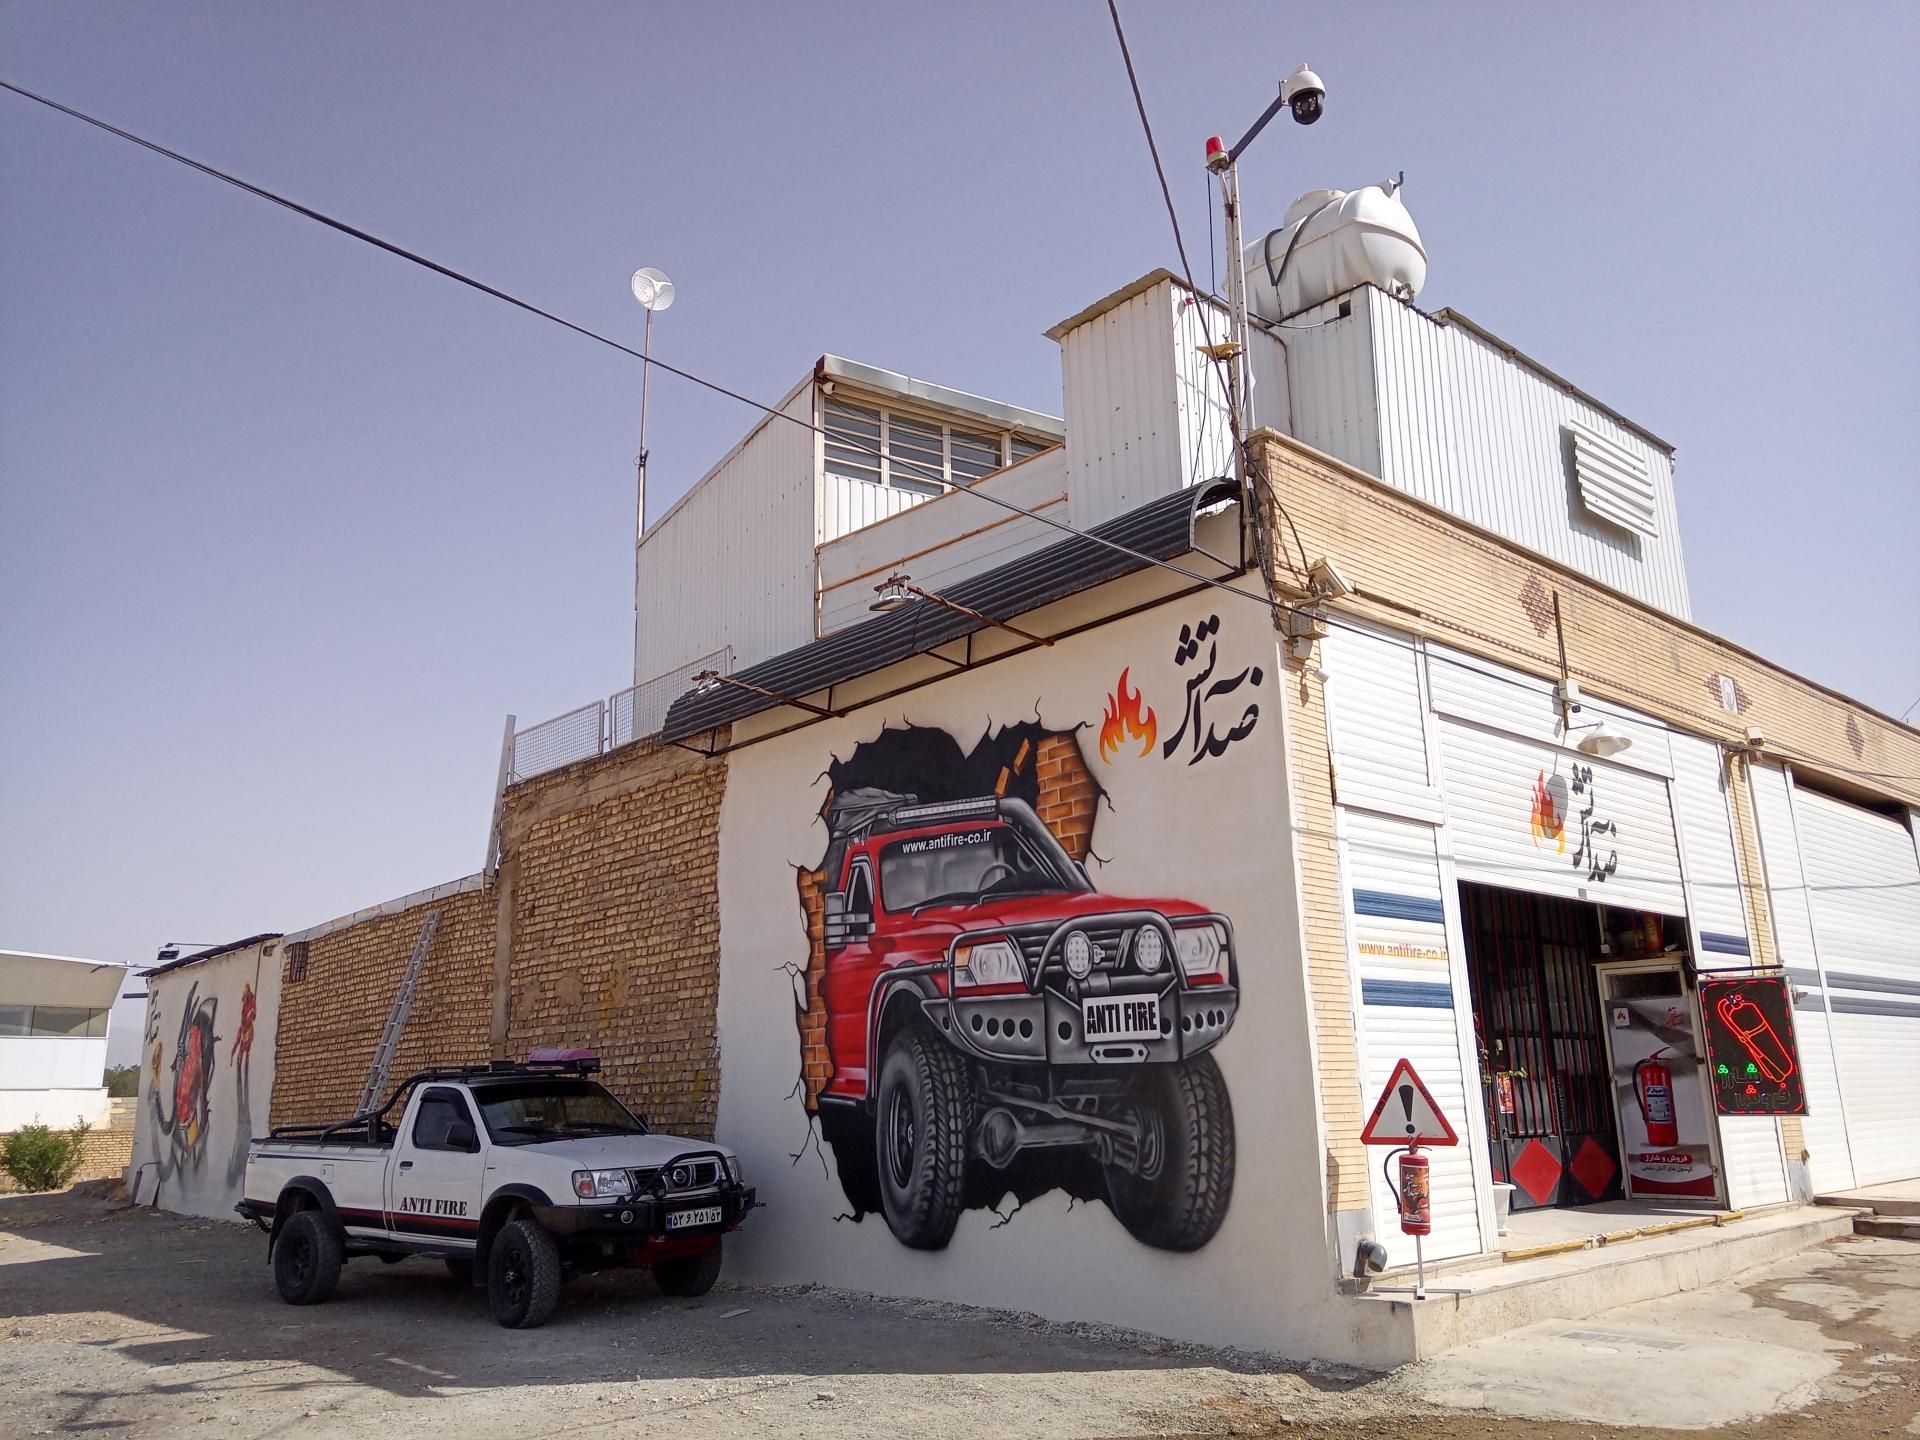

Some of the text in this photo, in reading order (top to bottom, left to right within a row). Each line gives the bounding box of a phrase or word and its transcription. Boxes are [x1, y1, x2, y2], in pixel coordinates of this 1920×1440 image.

[902, 829, 992, 854] www.antifire-co.ir
[1358, 943, 1448, 960] www.antifire-co.ir
[1086, 1001, 1157, 1034] ANTI FIRE
[399, 1197, 468, 1216] ANTI FIRE
